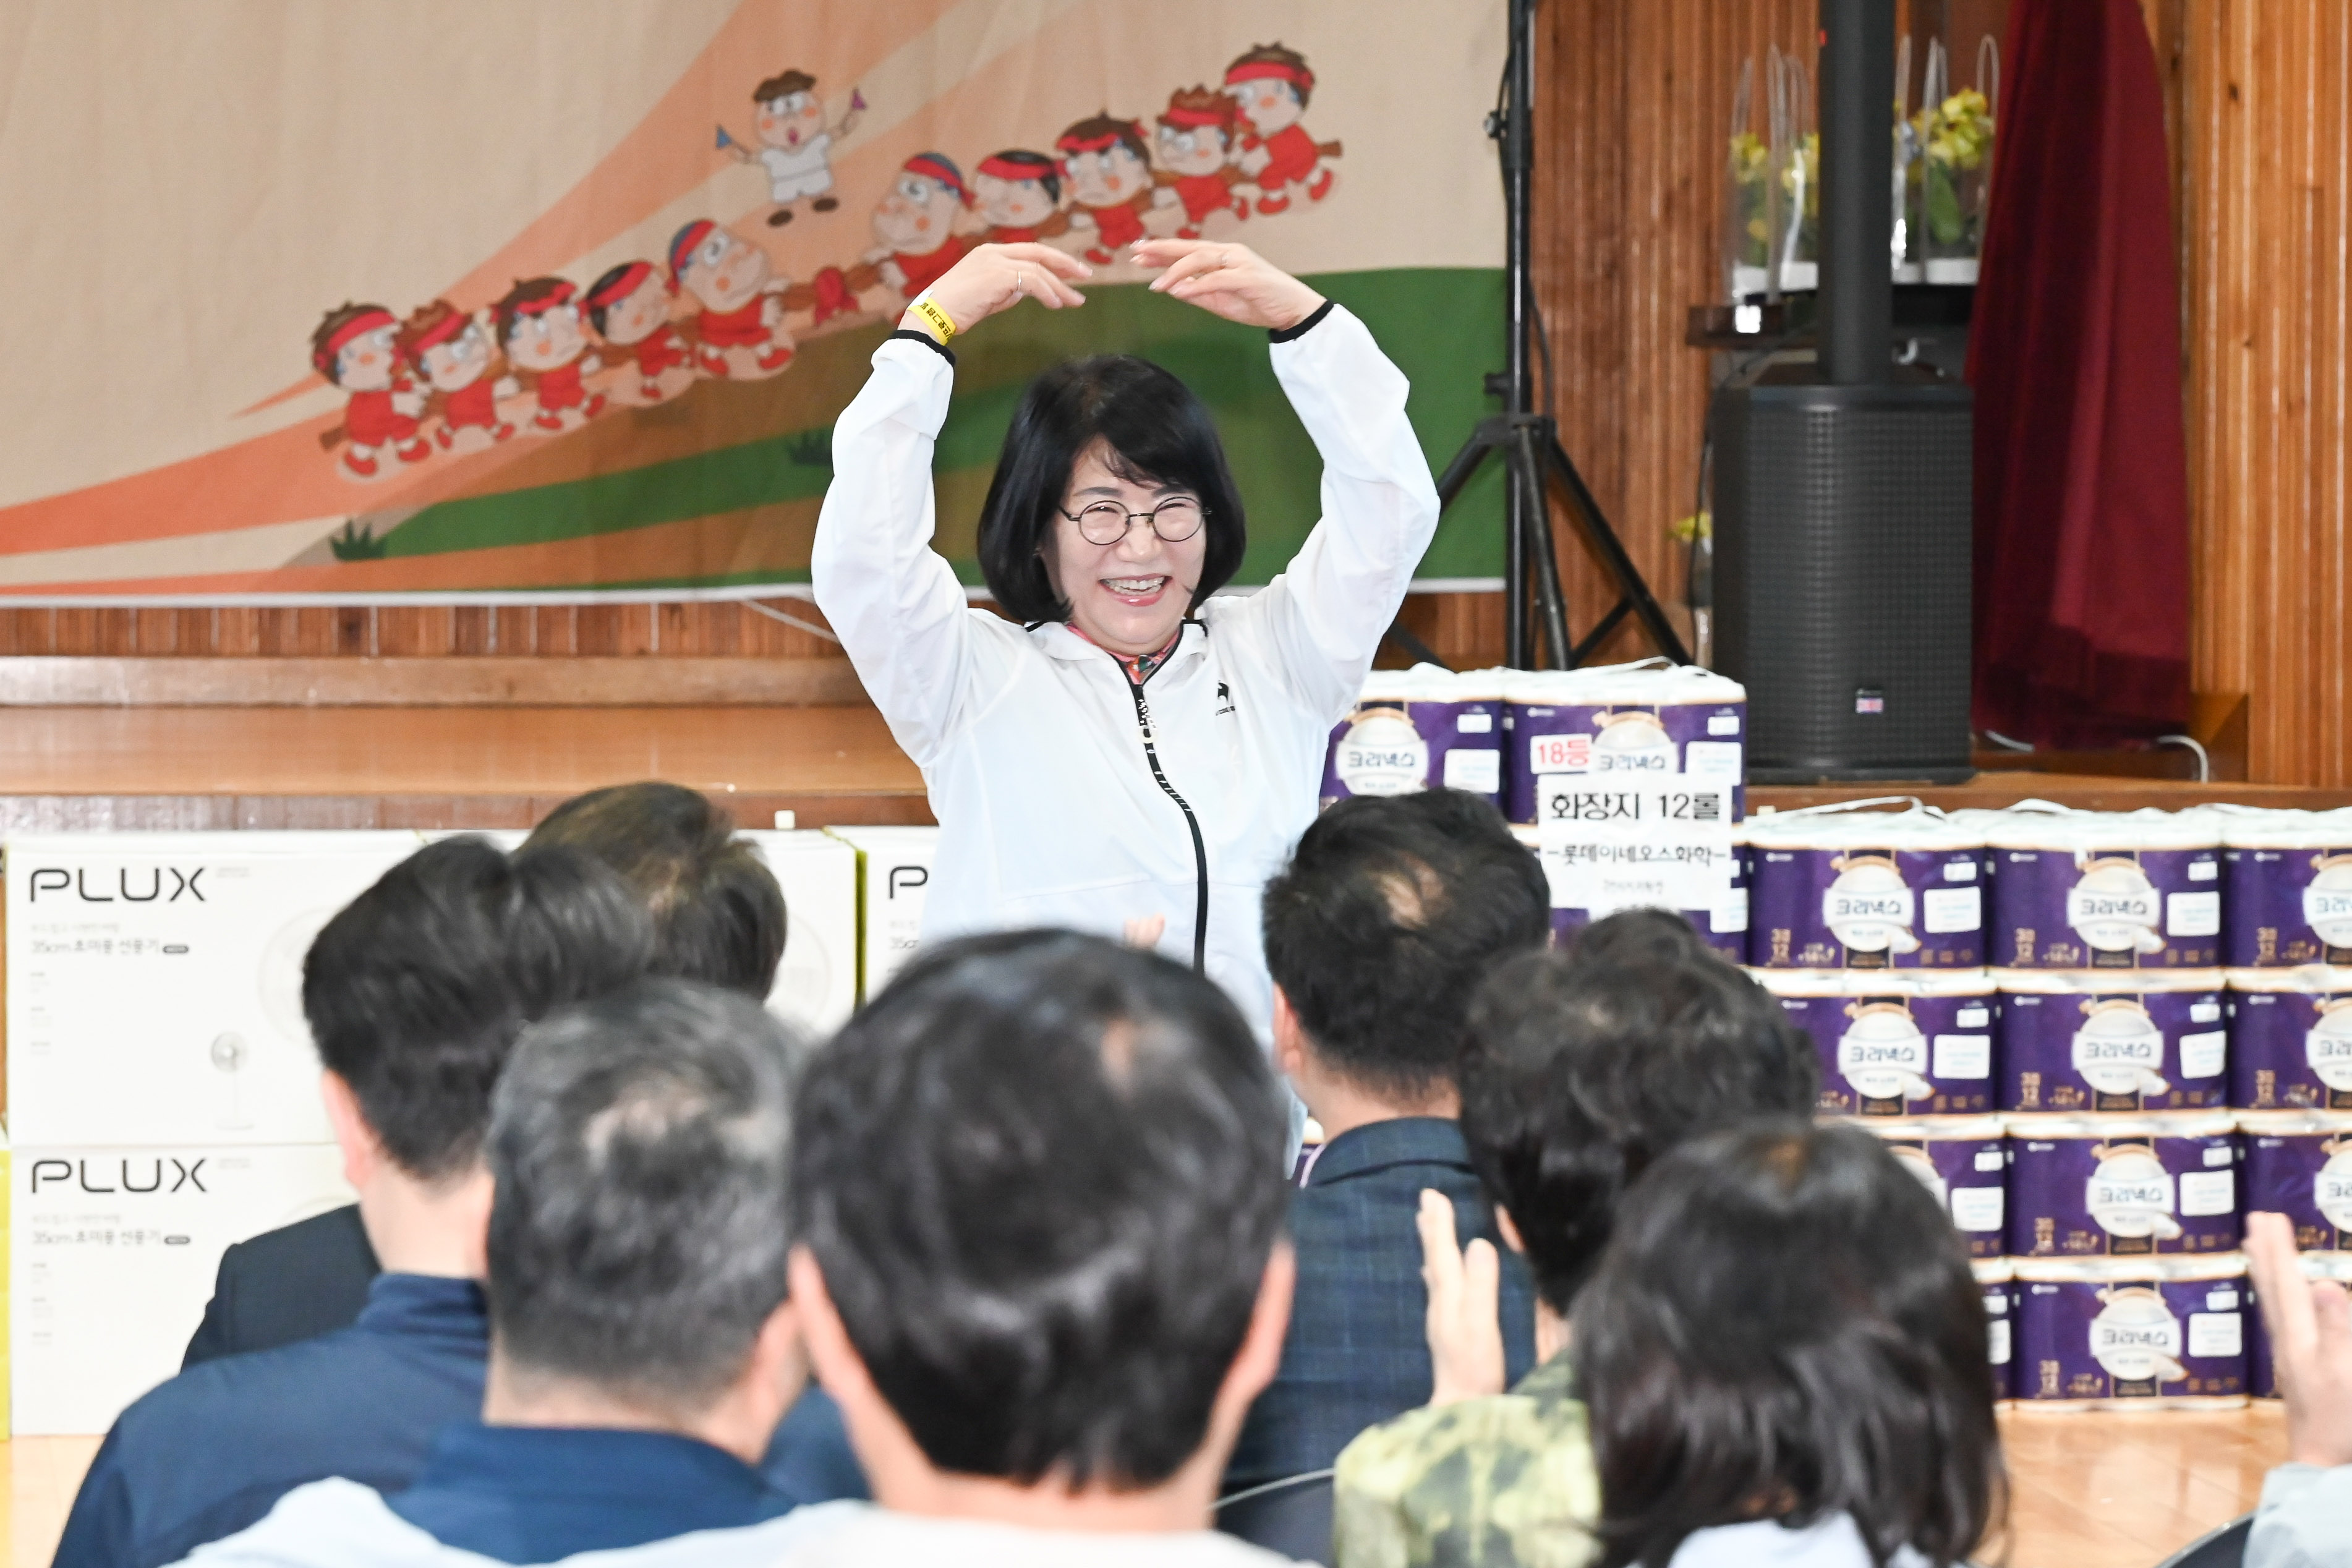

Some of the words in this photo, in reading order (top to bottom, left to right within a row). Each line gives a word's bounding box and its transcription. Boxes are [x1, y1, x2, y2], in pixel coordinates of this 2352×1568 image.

[1348, 751, 1415, 767] 크리넥스
[1538, 739, 1590, 767] 18등
[1551, 792, 1640, 820] 화장지
[1659, 792, 1719, 821] 12롤
[30, 867, 206, 903] PLUX
[1836, 899, 1901, 916] 크리넥스
[2080, 898, 2147, 916] 크리넥스
[1849, 1046, 1915, 1063] 크리넥스
[2085, 1042, 2152, 1059] 크리넥스
[32, 1158, 207, 1193] PLUX
